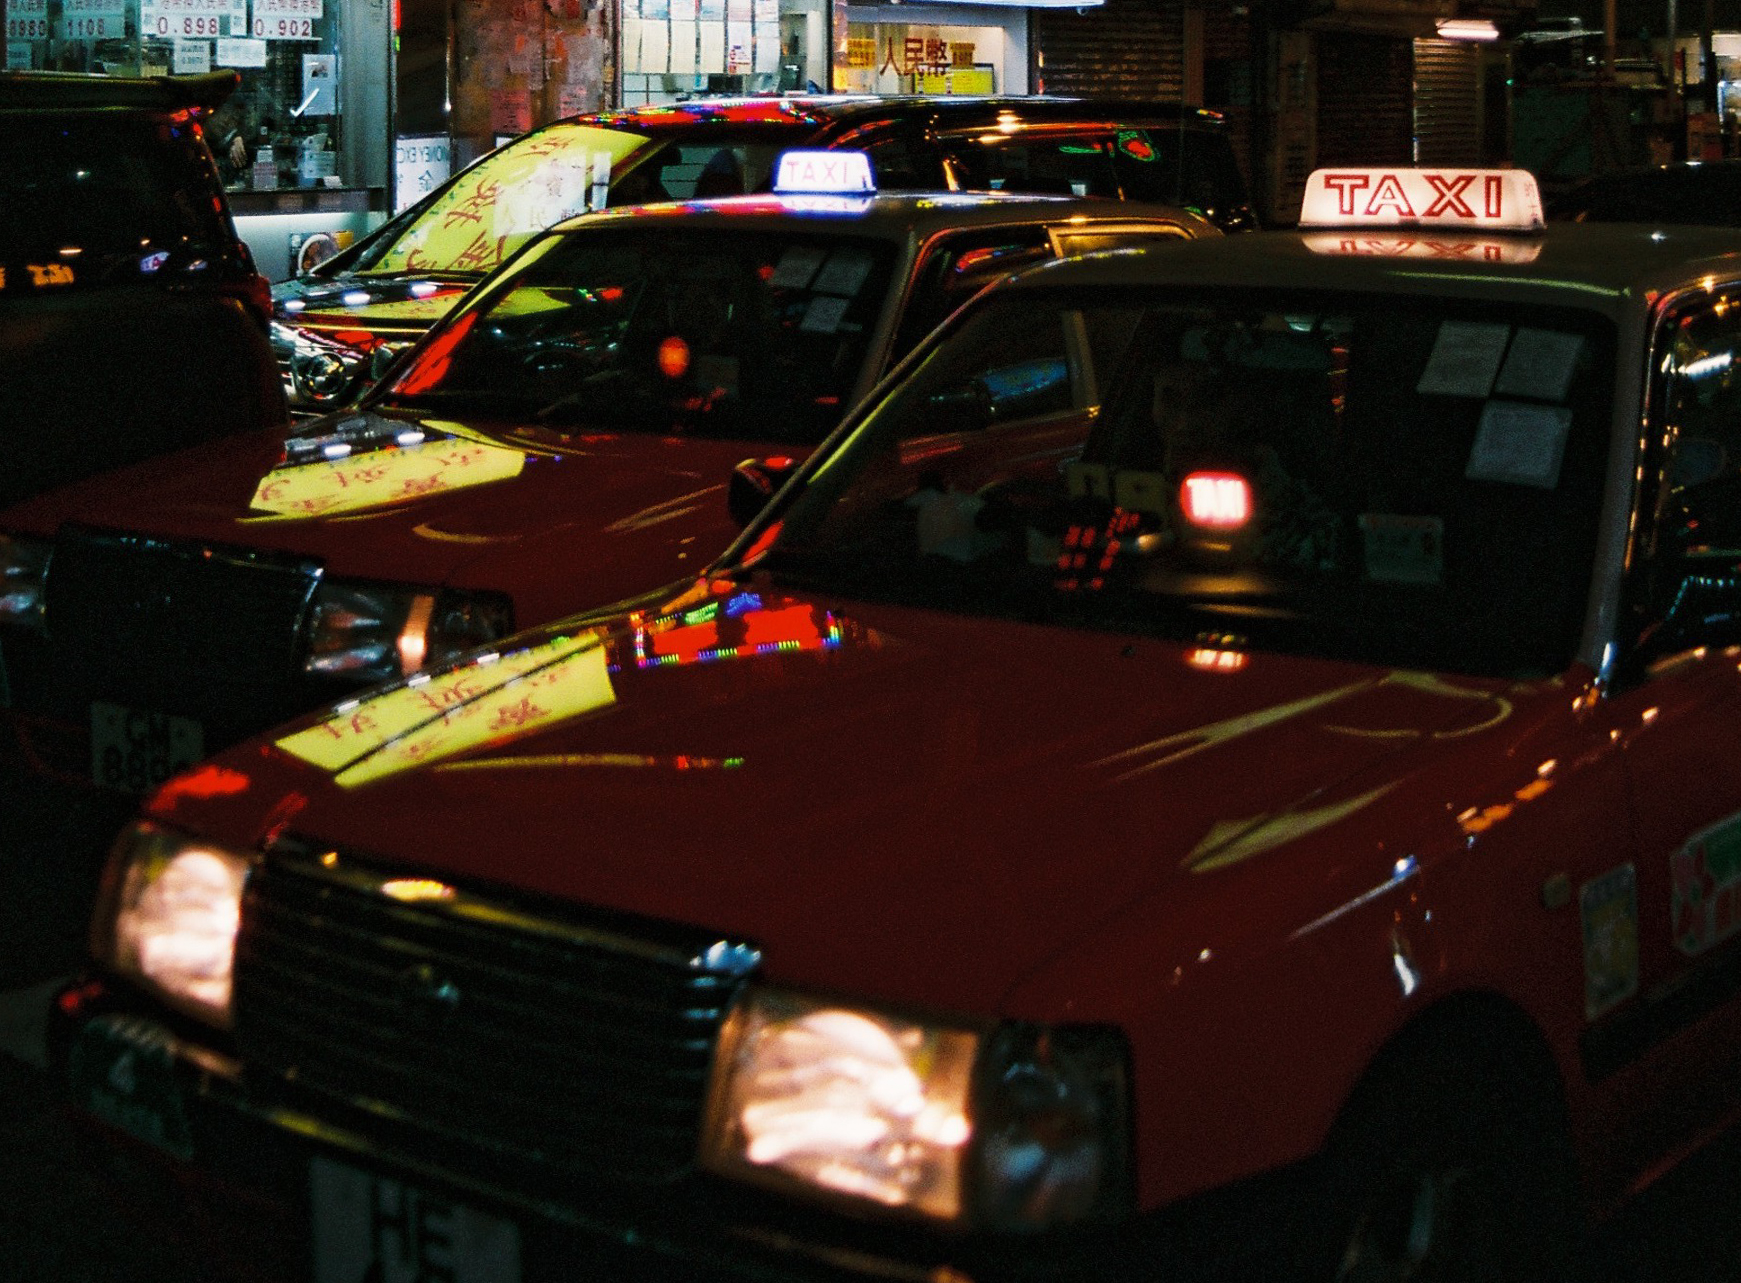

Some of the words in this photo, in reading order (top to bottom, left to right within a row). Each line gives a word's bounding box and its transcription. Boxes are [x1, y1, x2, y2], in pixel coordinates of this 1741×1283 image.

[158, 17, 217, 35] 0.898
[255, 18, 311, 36] 0.902
[786, 161, 848, 184] TAXI
[1324, 175, 1502, 218] TAXI
[372, 1179, 456, 1274] HE
